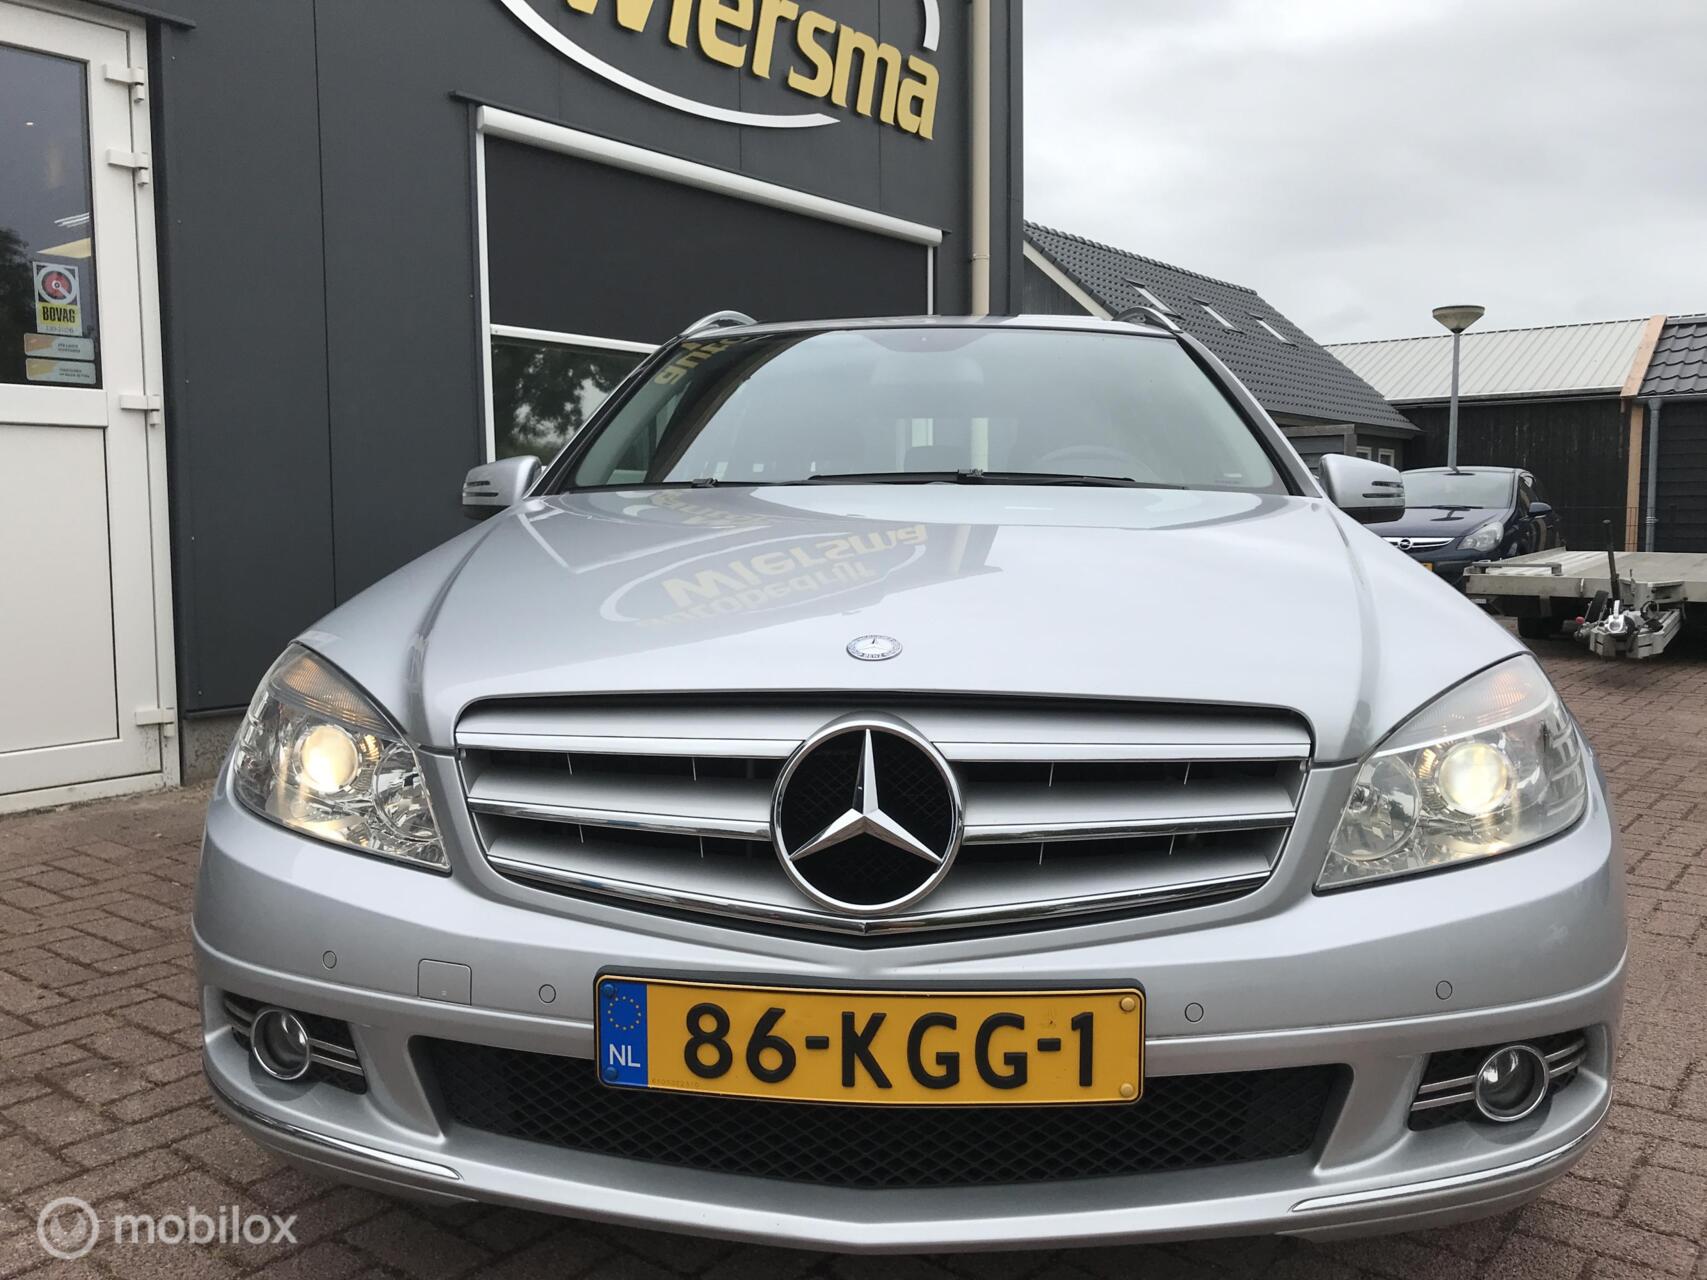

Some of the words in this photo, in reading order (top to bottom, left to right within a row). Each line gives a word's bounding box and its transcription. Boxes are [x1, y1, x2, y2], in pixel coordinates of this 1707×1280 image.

[42, 306, 75, 323] BOVAG
[608, 1044, 641, 1068] NL
[683, 1001, 1095, 1090] 86-KGG-1
